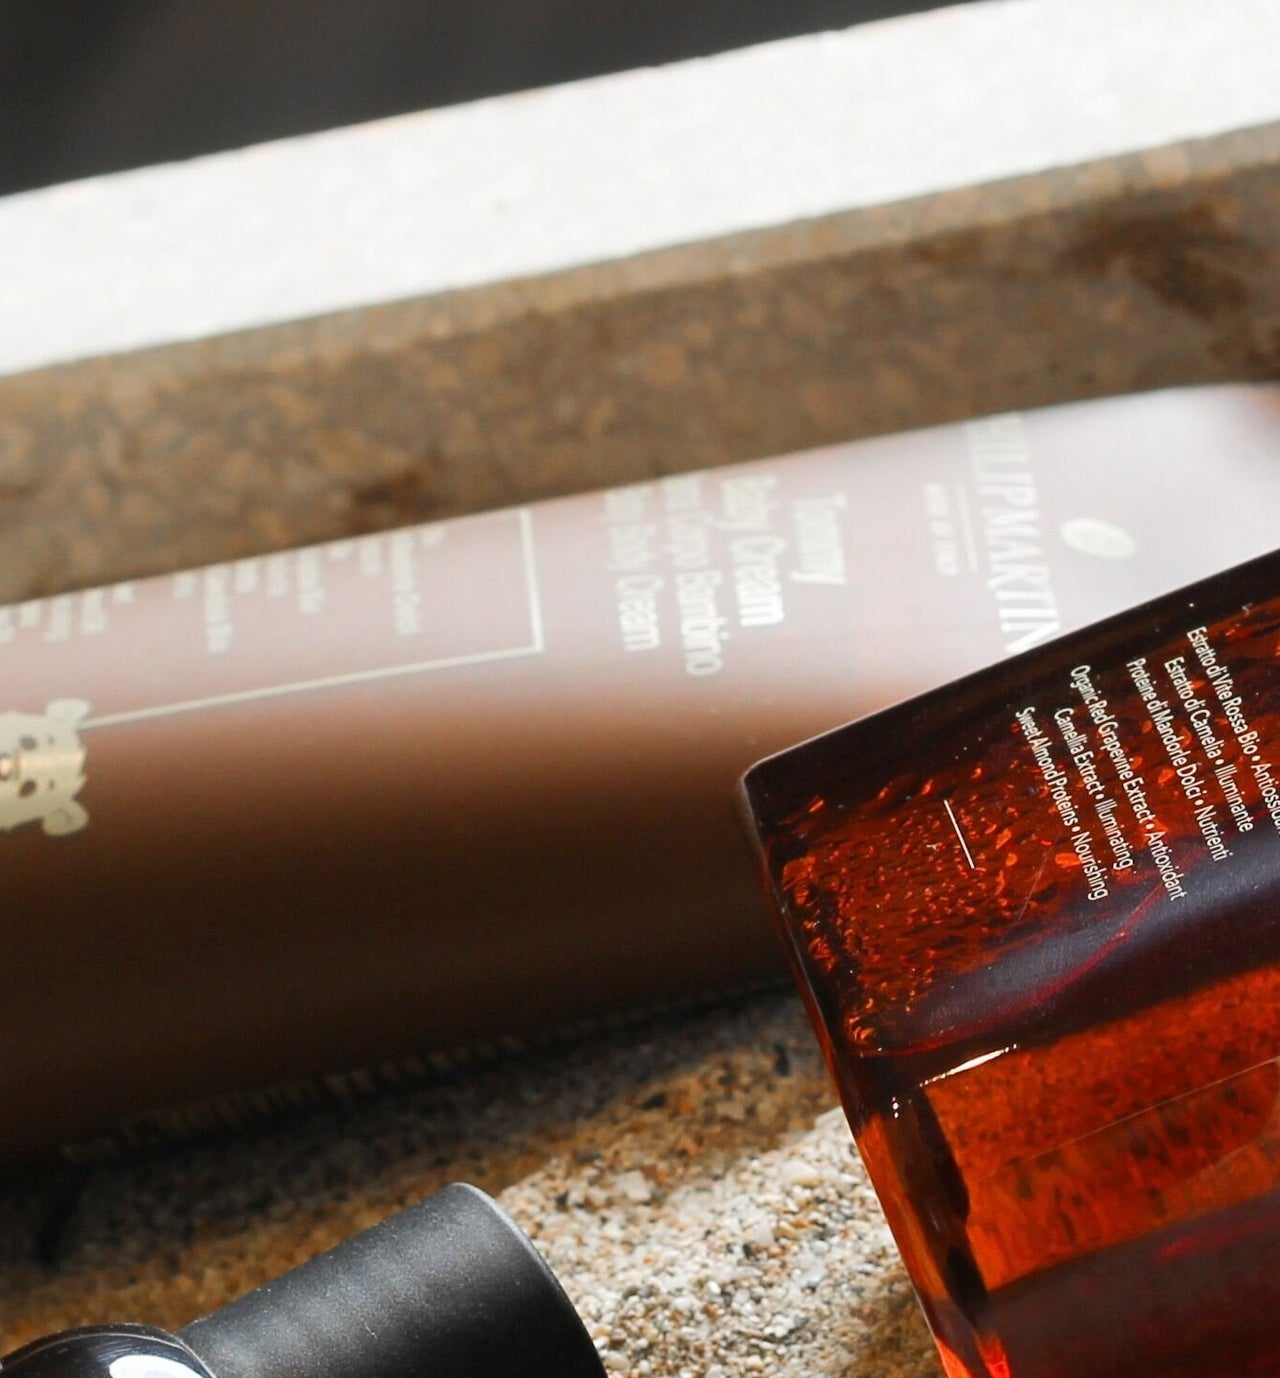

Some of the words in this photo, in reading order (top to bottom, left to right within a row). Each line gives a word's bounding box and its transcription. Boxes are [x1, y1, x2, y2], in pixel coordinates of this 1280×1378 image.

[1186, 625, 1216, 666] Estratto
[1069, 664, 1101, 704] Organic
[1125, 657, 1157, 701] Proteine
[1163, 656, 1194, 699] Estratto
[1205, 664, 1227, 678] di
[1211, 672, 1233, 700] Vite
[1014, 706, 1043, 740] Sweet
[1087, 699, 1115, 724] Red
[1145, 699, 1168, 713] di
[1183, 698, 1205, 712] di
[1221, 696, 1248, 734] Rossa
[1097, 720, 1134, 780] Grapevine
[1151, 708, 1190, 766] Mandorle
[1189, 708, 1224, 758] Camelia
[1237, 730, 1260, 754] Bio
[1028, 736, 1065, 780] Almond
[1047, 776, 1078, 826] Proteins
[1053, 707, 1087, 754] Camellia
[1073, 750, 1105, 795] Extract
[1094, 798, 1133, 870] Illuminating
[1122, 776, 1155, 823] Extract
[1175, 762, 1207, 799] Dolci
[1214, 763, 1253, 832] Illuminante
[1193, 804, 1233, 861] Nutrienti
[1070, 831, 1108, 900] Nourishing
[1145, 831, 1187, 901] Antioxidant
